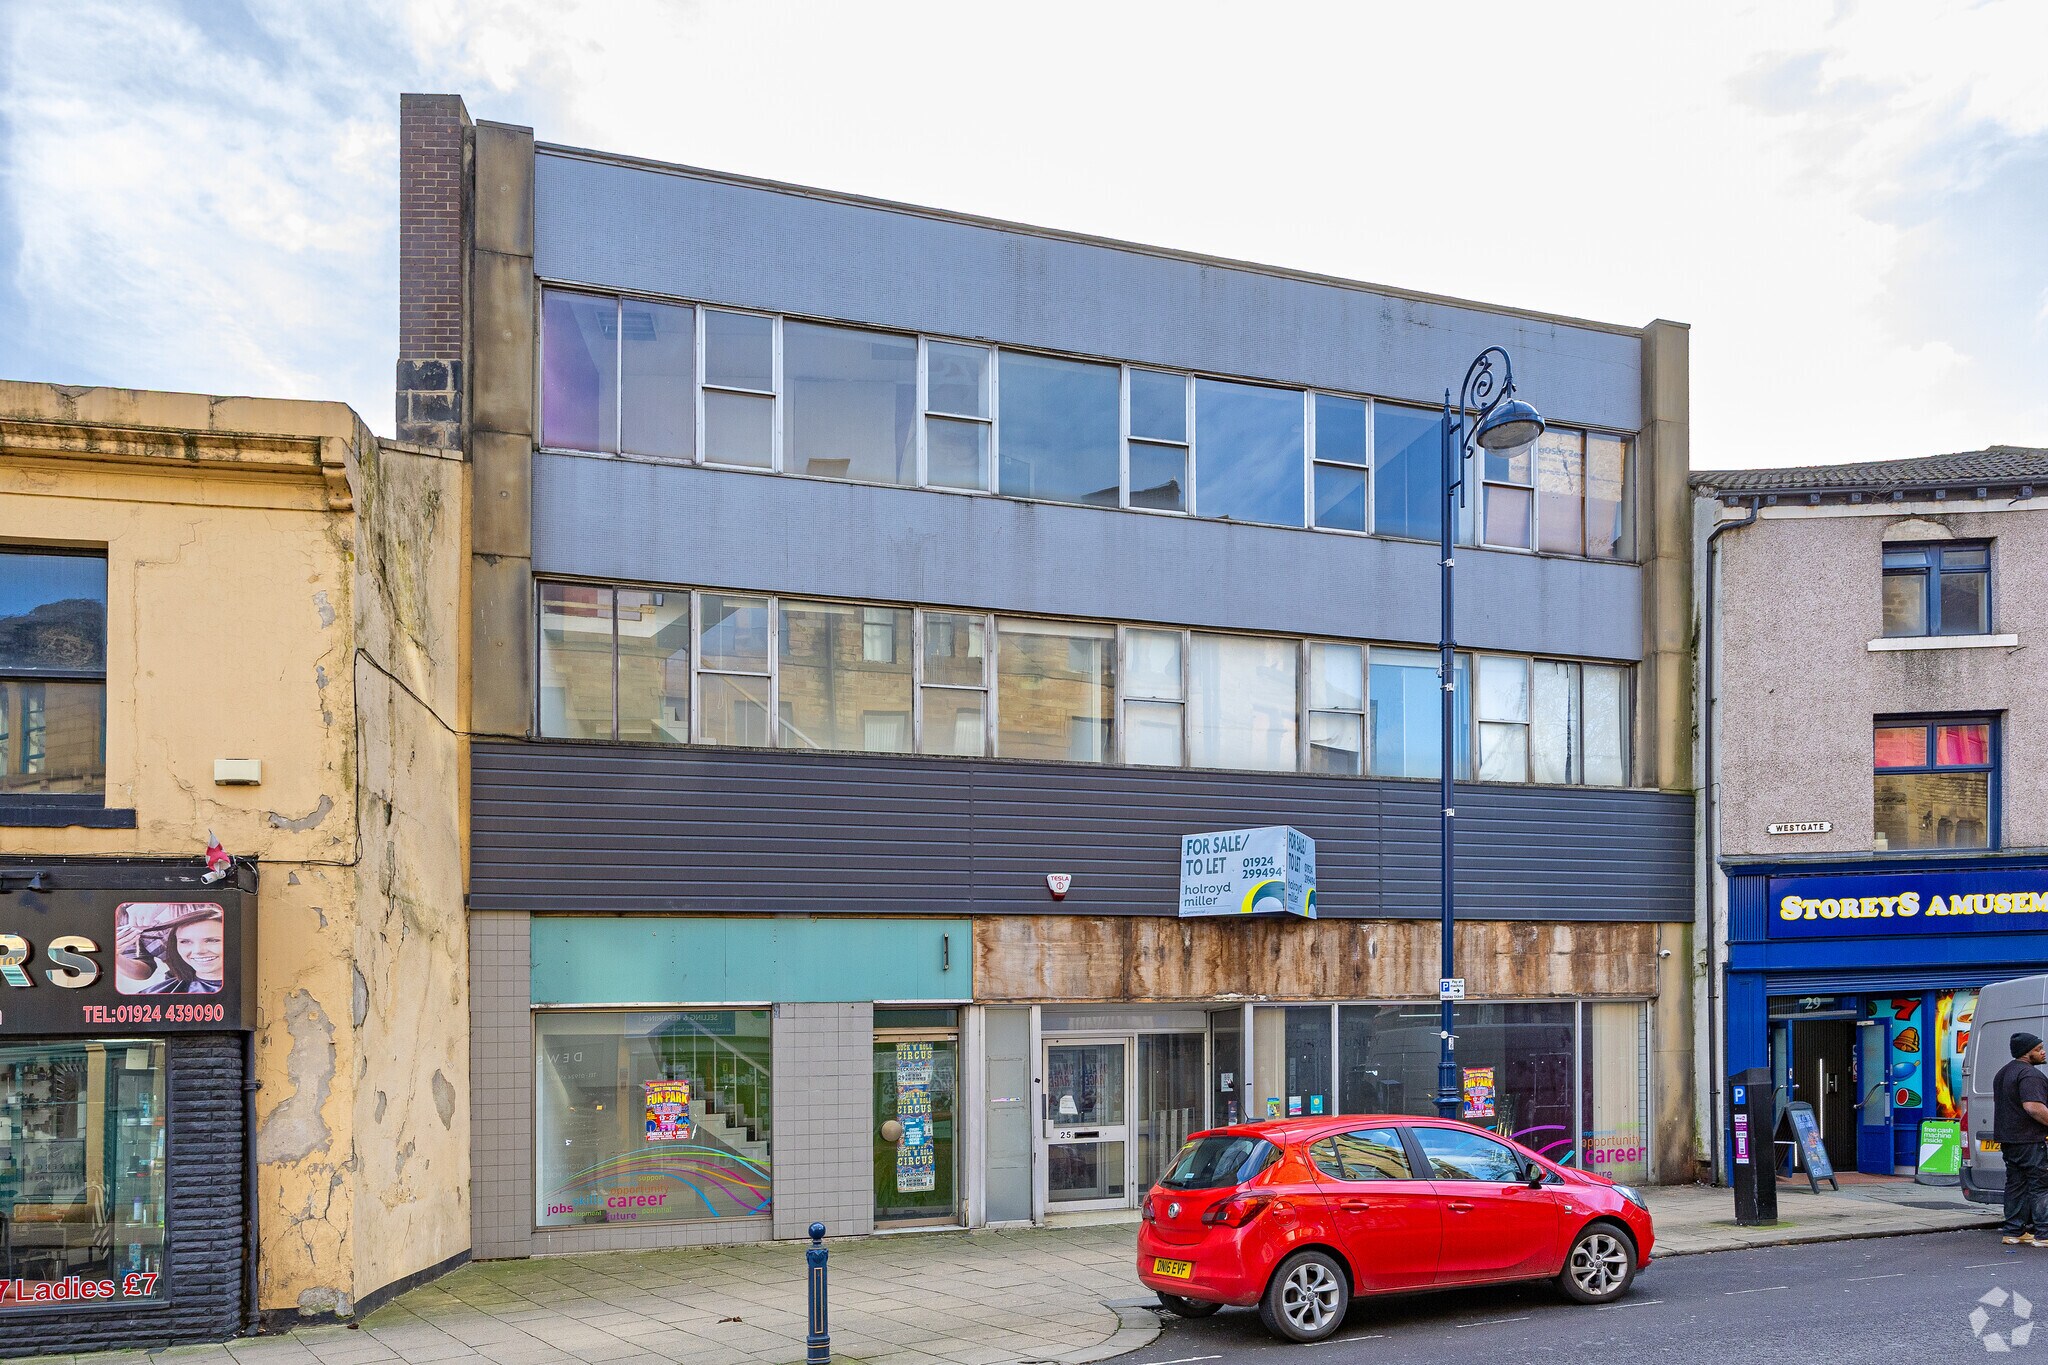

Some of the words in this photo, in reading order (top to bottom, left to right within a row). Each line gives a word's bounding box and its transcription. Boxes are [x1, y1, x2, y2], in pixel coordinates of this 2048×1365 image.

[1775, 823, 1824, 832] WESTGATE
[1187, 838, 1210, 856] FOR
[1213, 834, 1250, 854] SALE/
[1288, 831, 1297, 851] FOR
[1186, 859, 1203, 876] TO
[1206, 857, 1227, 874] LET
[1242, 856, 1274, 868] 01924
[1288, 853, 1294, 870] TO
[1242, 867, 1282, 879] 299494
[1184, 882, 1231, 896] holroyd
[1184, 896, 1218, 907] miller
[1925, 892, 2048, 917] AMUSEM
[1804, 996, 1821, 1011] 29
[83, 1005, 161, 1023] TEL:01924
[165, 1004, 224, 1022] 439090
[897, 1051, 932, 1060] CIRCUS
[1464, 1078, 1476, 1089] FUN
[1477, 1077, 1493, 1088] PARK
[647, 1092, 663, 1106] FUN
[665, 1091, 688, 1105] PARK
[1735, 1088, 1744, 1102] P
[897, 1105, 932, 1114] CIRCUS
[1060, 1131, 1071, 1139] 25
[1581, 1134, 1641, 1151] opportunity
[1985, 1140, 2001, 1150] DV2
[897, 1156, 933, 1166] CIRCUS
[1585, 1147, 1646, 1165] career
[610, 1184, 669, 1196] opportunity
[607, 1194, 667, 1209] career
[547, 1203, 574, 1216] jobs
[606, 1212, 637, 1221] future
[642, 1206, 672, 1214] potential
[1157, 1260, 1171, 1273] DN16
[1172, 1263, 1187, 1275] EVF
[16, 1276, 115, 1301] Ladies
[123, 1272, 158, 1297] £7
